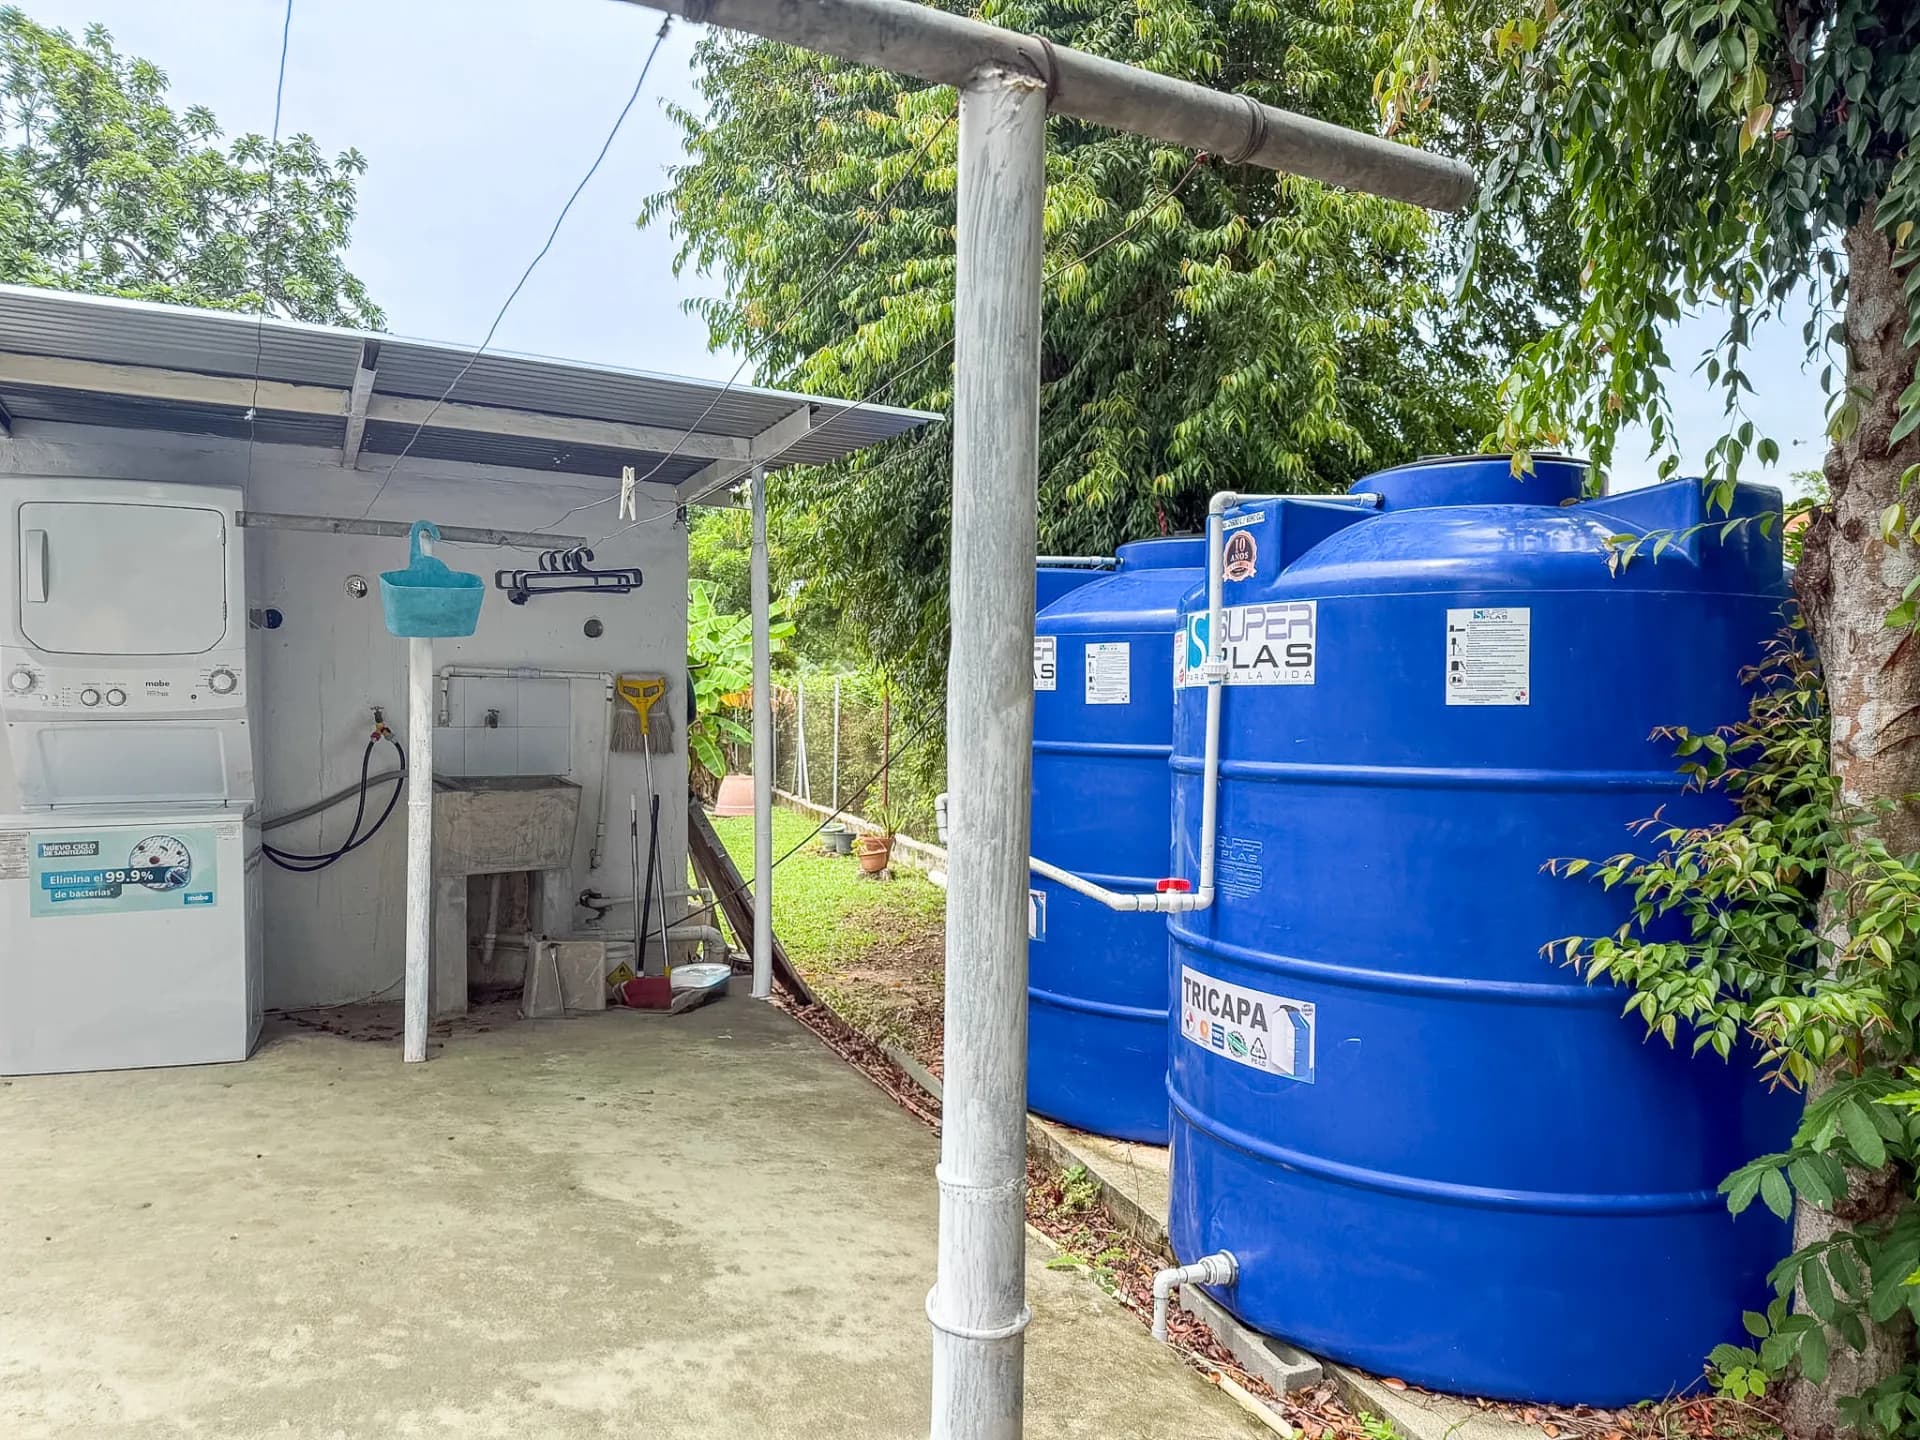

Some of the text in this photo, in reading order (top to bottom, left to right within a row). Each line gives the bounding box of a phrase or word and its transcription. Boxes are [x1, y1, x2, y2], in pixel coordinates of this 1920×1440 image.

[1247, 671, 1263, 680] LA
[1273, 670, 1312, 679] VIDA
[50, 869, 154, 885] Elimina el 99.9%
[54, 890, 67, 899] de
[1183, 976, 1269, 1033] TRICAPA
